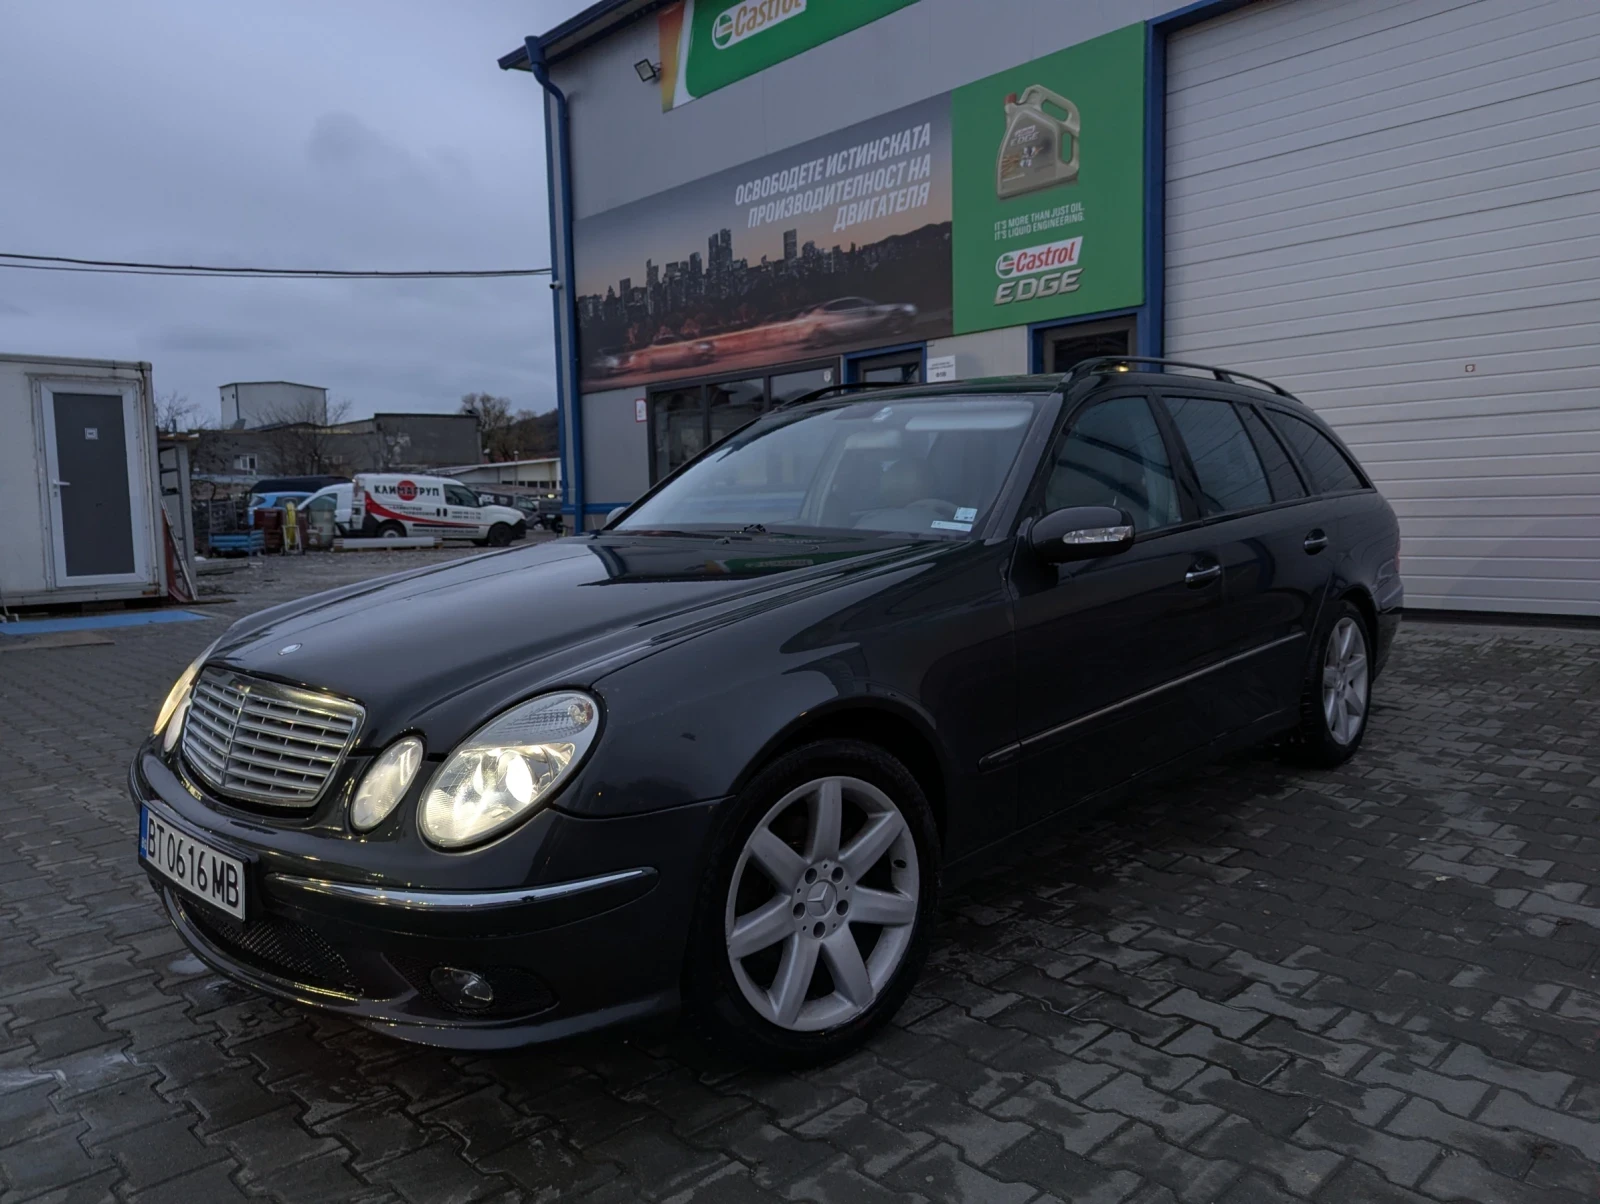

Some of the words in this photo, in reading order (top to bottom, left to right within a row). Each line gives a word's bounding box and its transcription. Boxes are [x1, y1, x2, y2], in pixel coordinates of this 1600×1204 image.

[734, 0, 802, 37] Castro
[735, 158, 825, 206] ОСВОБОДЕТЕ
[825, 122, 931, 178] ИСТИНСКАТА
[748, 161, 907, 228] ПРОИЗВОДИТЕЛНОСТ
[907, 153, 931, 182] НА
[833, 182, 931, 232] ДВИГАТЕЛЯ
[994, 219, 1007, 231] IT'S
[1008, 214, 1029, 227] MORE
[1031, 209, 1050, 222] THAN
[1051, 204, 1070, 218] JUST
[994, 230, 1007, 241] IT'S
[1008, 224, 1032, 238] LIQUID
[1016, 241, 1076, 273] Castrol
[994, 268, 1084, 306] EDGE
[374, 485, 440, 497] КЛИМАГРУП
[148, 818, 165, 865] BT
[167, 832, 208, 892] 0616
[212, 856, 239, 908] MB
